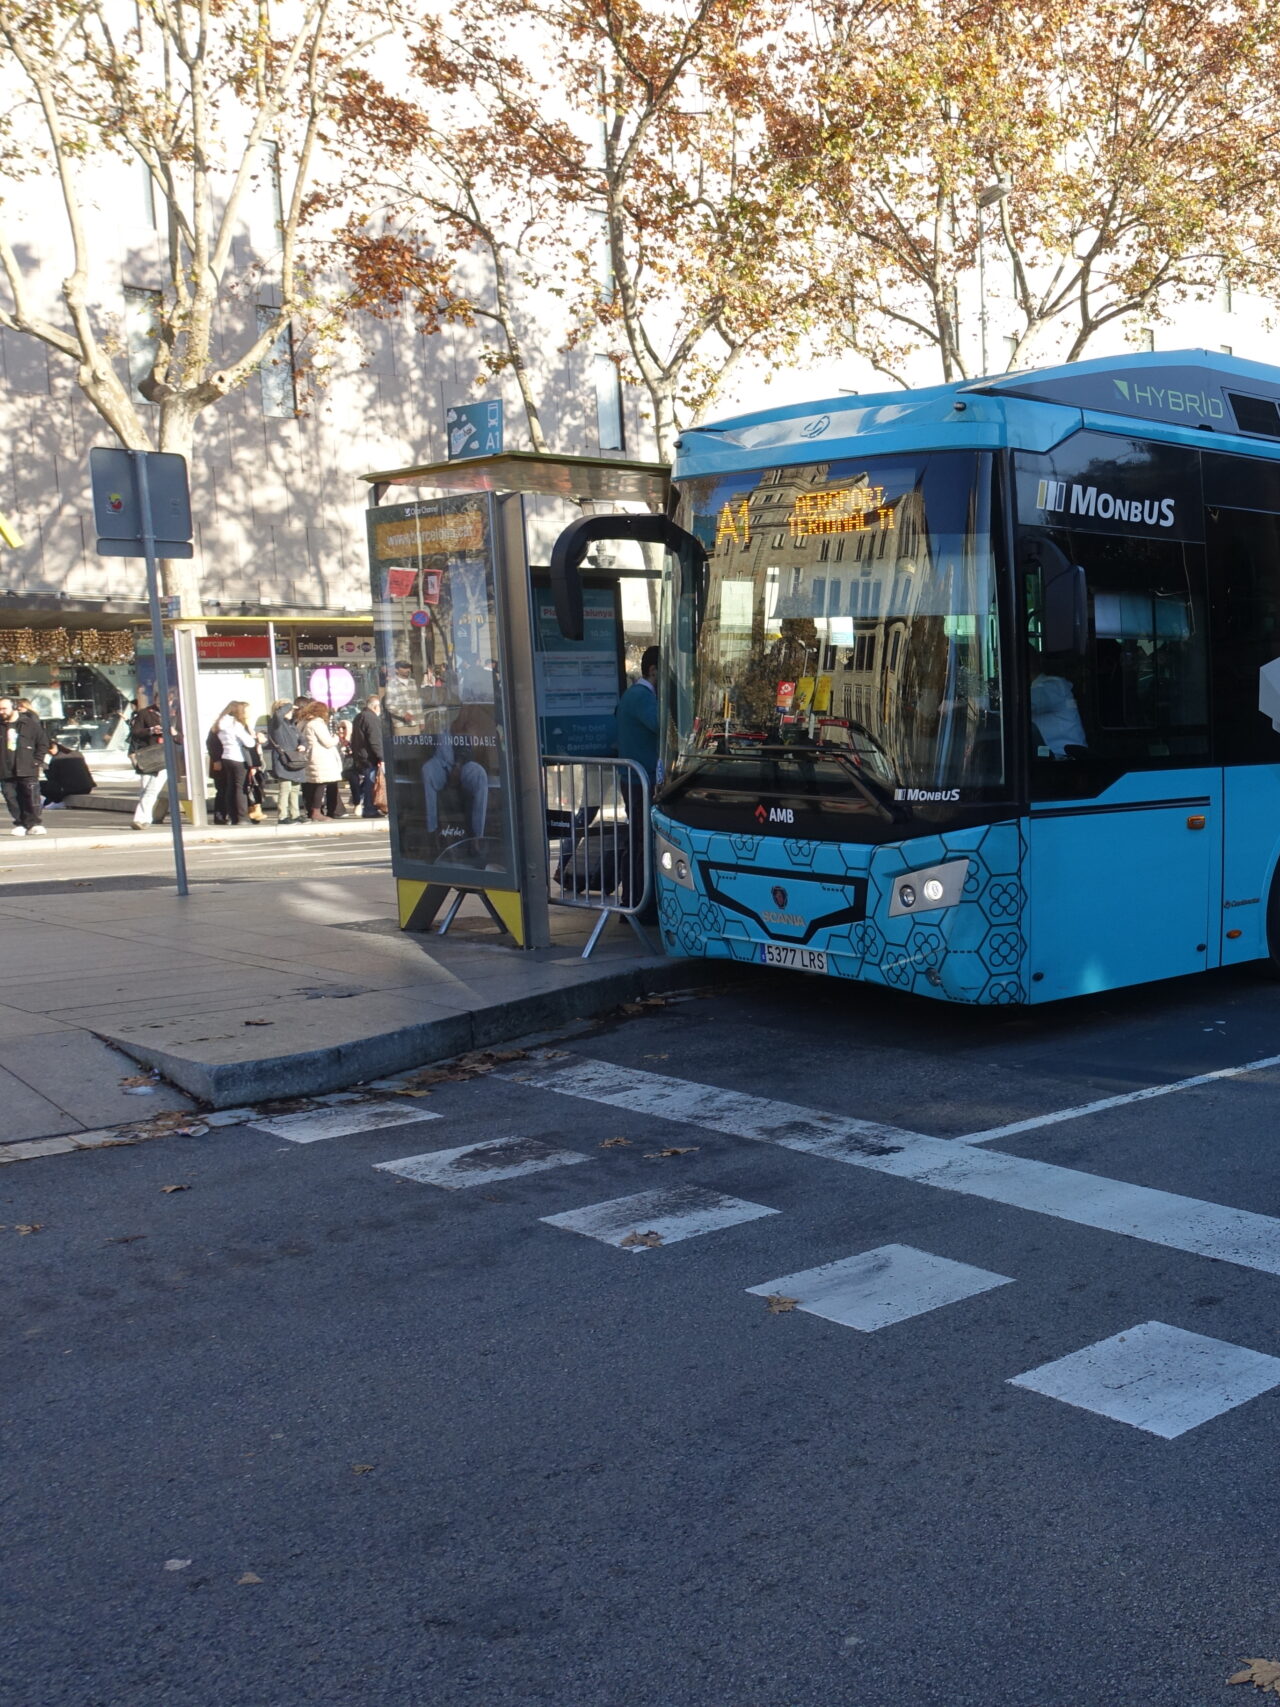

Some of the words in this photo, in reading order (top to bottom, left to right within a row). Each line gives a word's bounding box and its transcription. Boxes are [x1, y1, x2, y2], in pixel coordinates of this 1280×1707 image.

[1133, 382, 1225, 420] HYBRID
[485, 431, 500, 450] A1
[795, 486, 884, 515] AEROPORT
[717, 499, 750, 545] A1
[788, 511, 872, 537] TERMINAL
[878, 508, 895, 530] T1
[298, 642, 334, 652] Enllaços
[393, 736, 405, 745] UN
[444, 736, 496, 747] INOBLIDABLE
[769, 807, 794, 824] AMB
[761, 911, 807, 926] SCANIA
[766, 943, 797, 966] 5377
[801, 951, 825, 970] LRS
